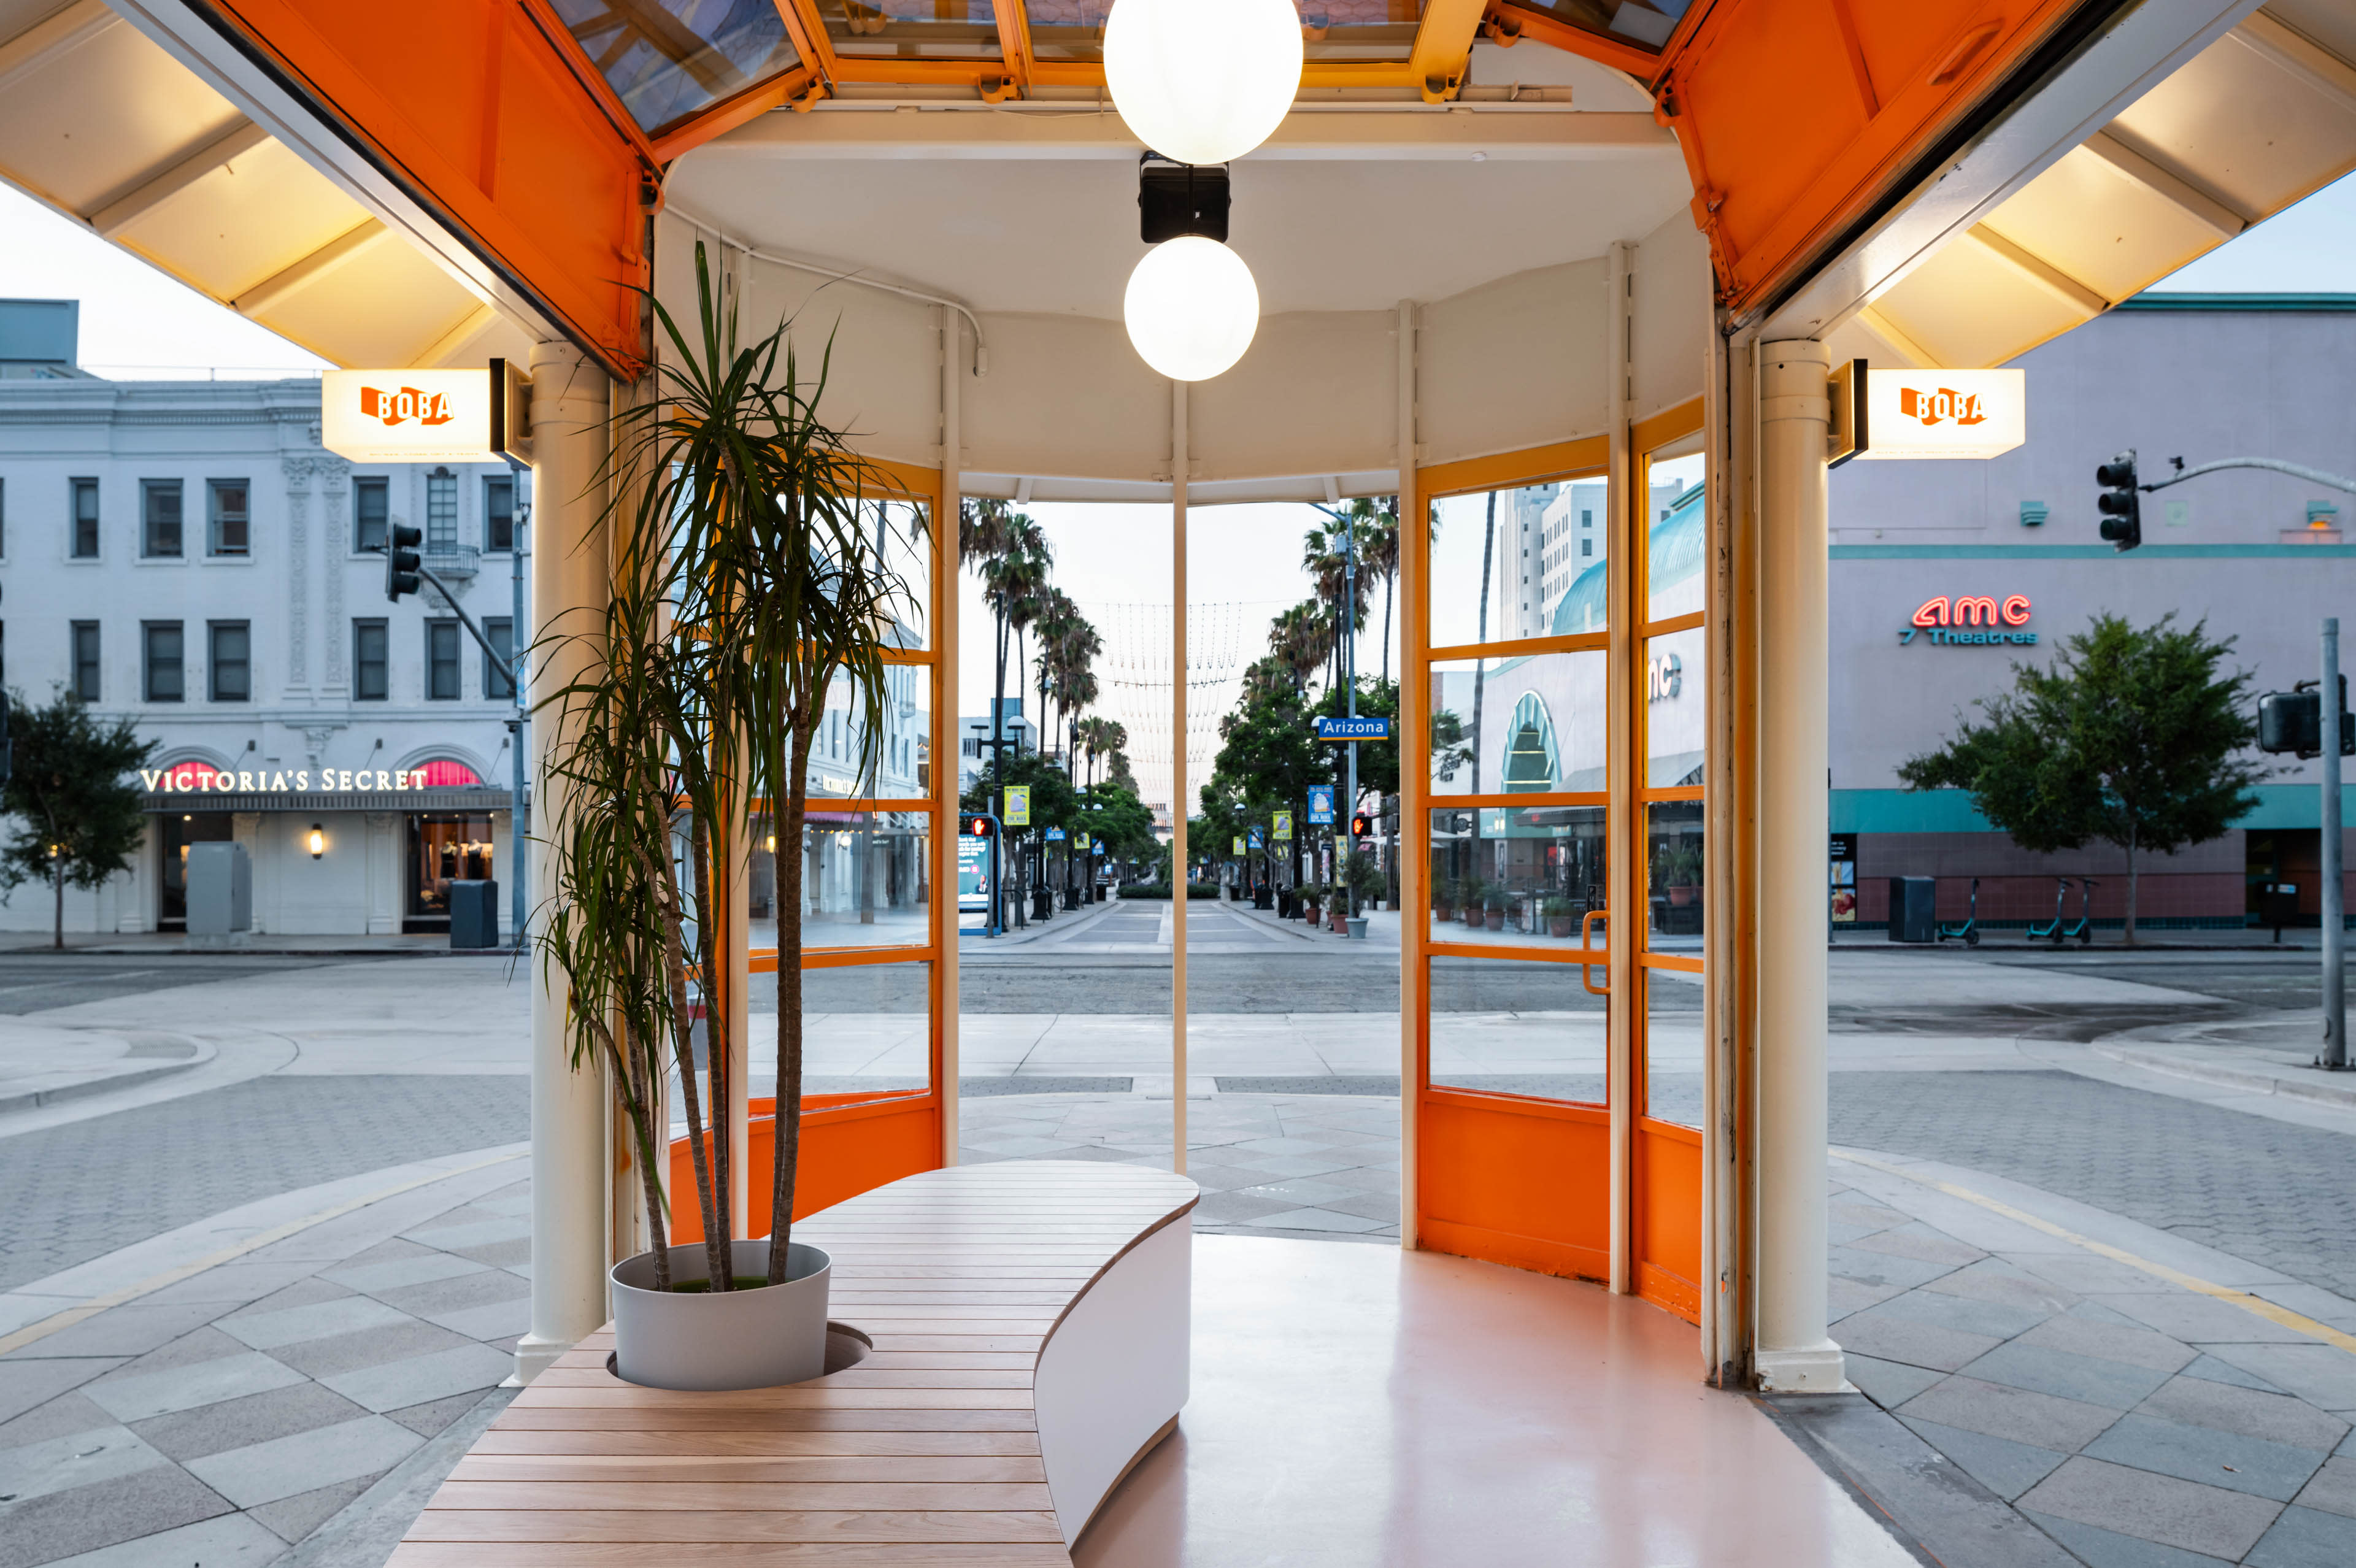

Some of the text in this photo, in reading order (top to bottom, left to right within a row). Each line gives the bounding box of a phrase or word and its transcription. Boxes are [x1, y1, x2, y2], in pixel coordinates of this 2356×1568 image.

[377, 391, 455, 420] BOBA
[1915, 391, 1988, 420] BOBA
[1898, 628, 2039, 645] 7 Theatres
[1323, 721, 1384, 733] Arizona
[140, 768, 428, 792] VICTORIA'S SECRET
